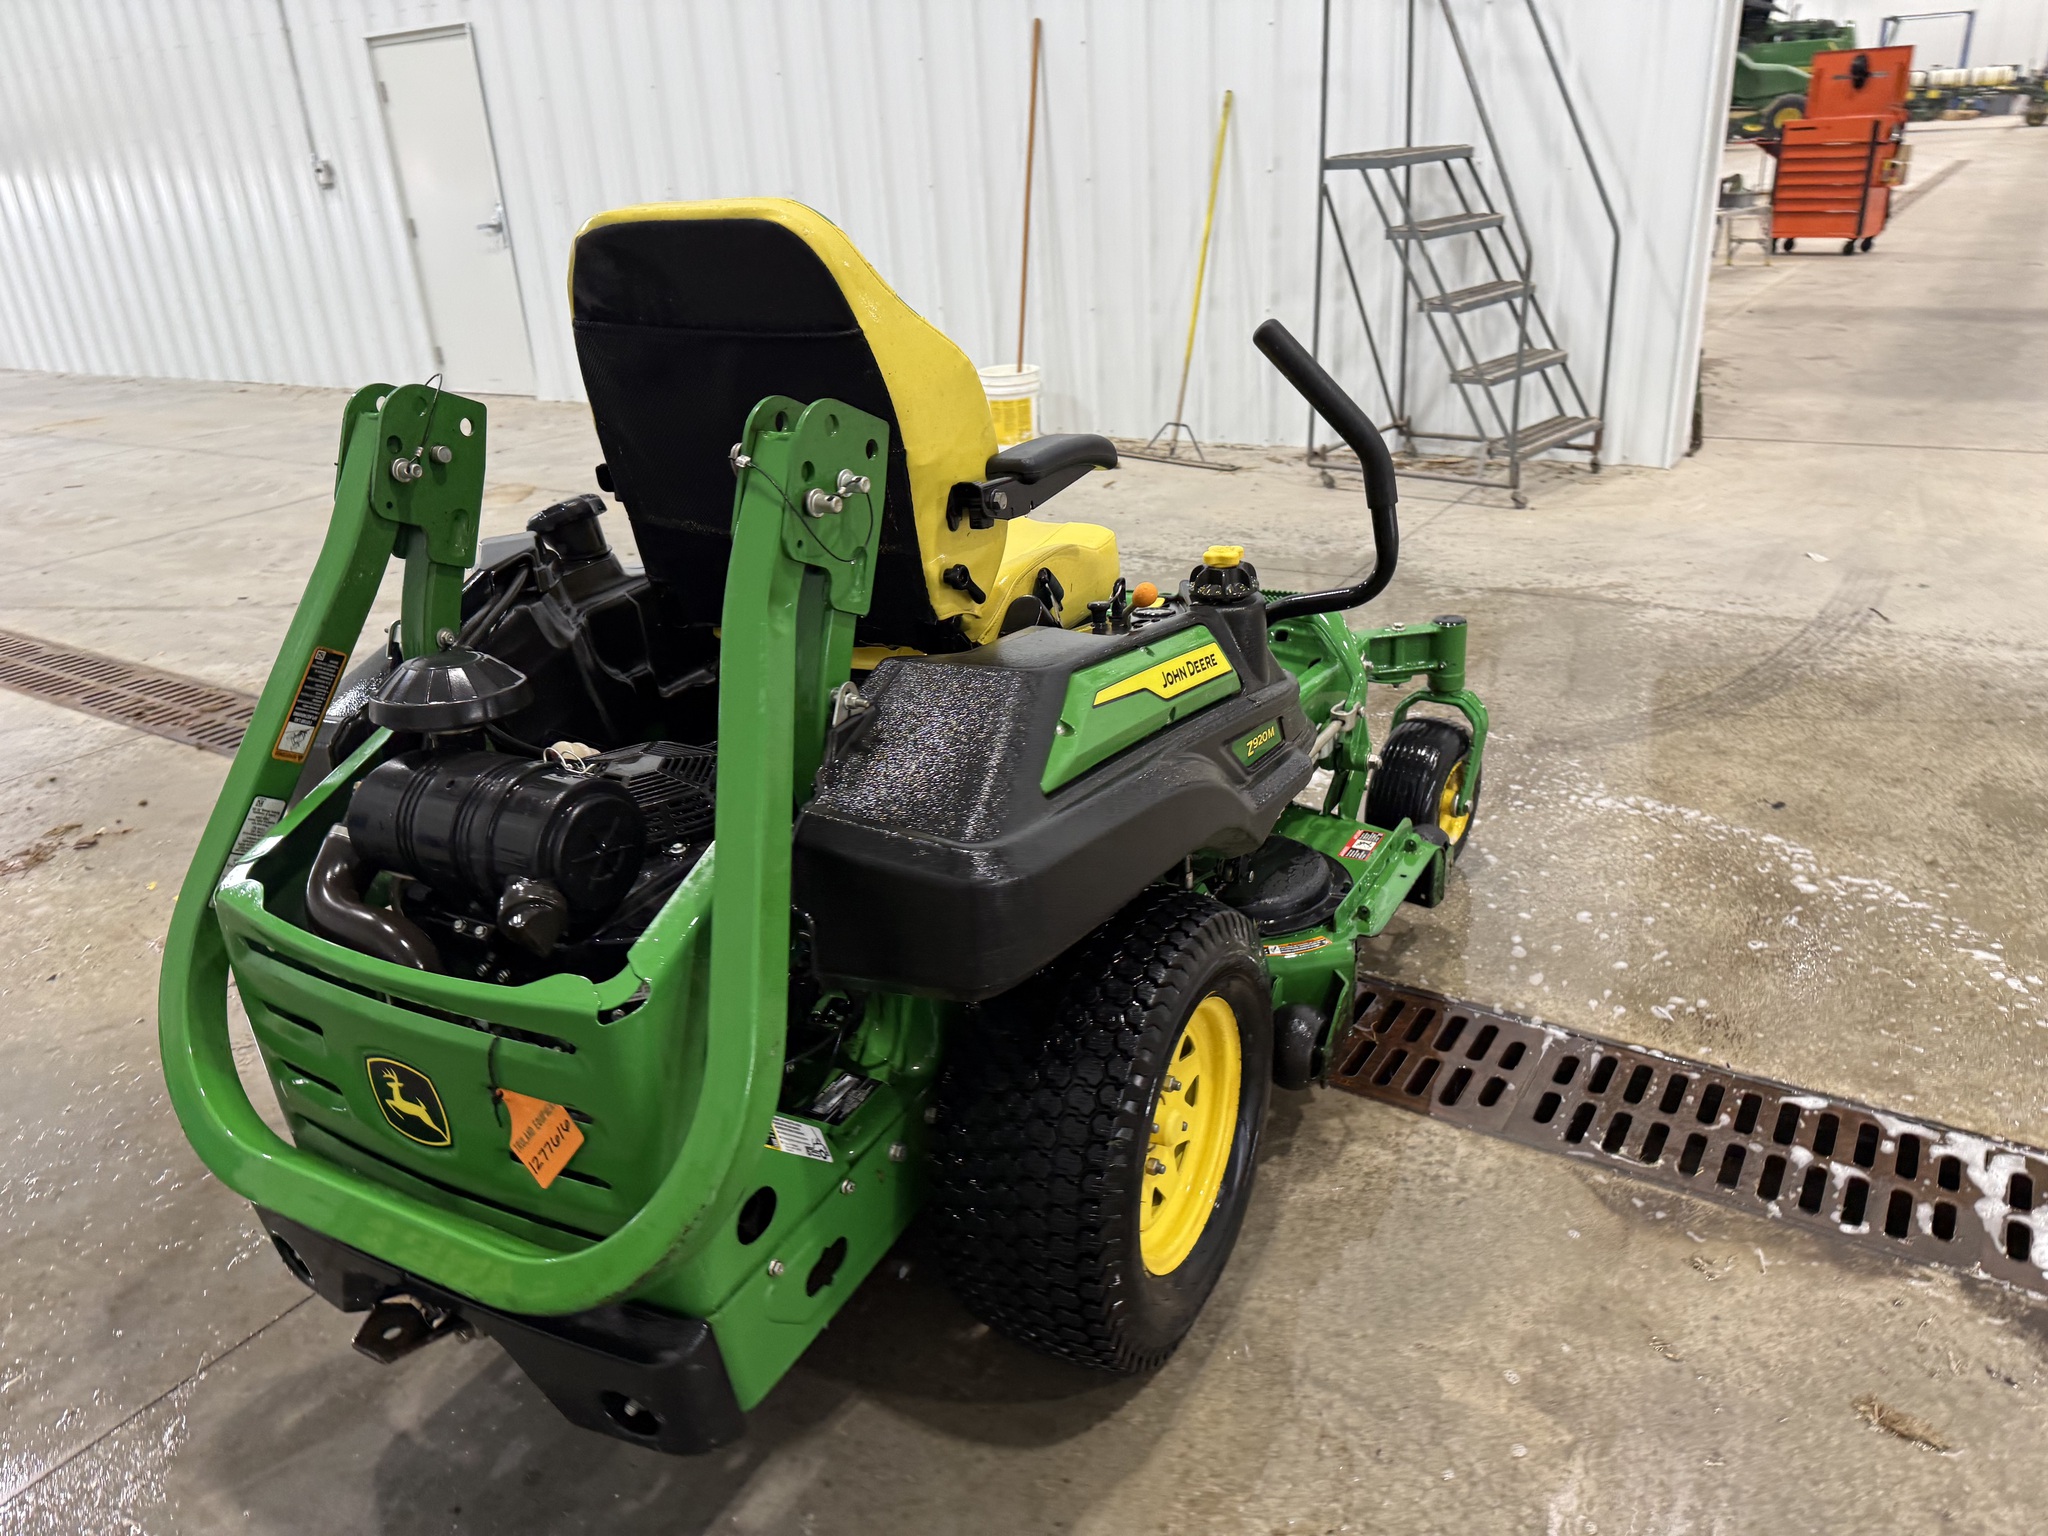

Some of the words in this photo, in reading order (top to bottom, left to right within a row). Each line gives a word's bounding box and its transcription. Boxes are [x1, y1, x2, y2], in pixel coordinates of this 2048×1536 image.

[1161, 666, 1187, 688] JOHN
[1186, 653, 1218, 677] DEERE
[1246, 725, 1275, 757] Z920M
[528, 1119, 571, 1175] 1277616
